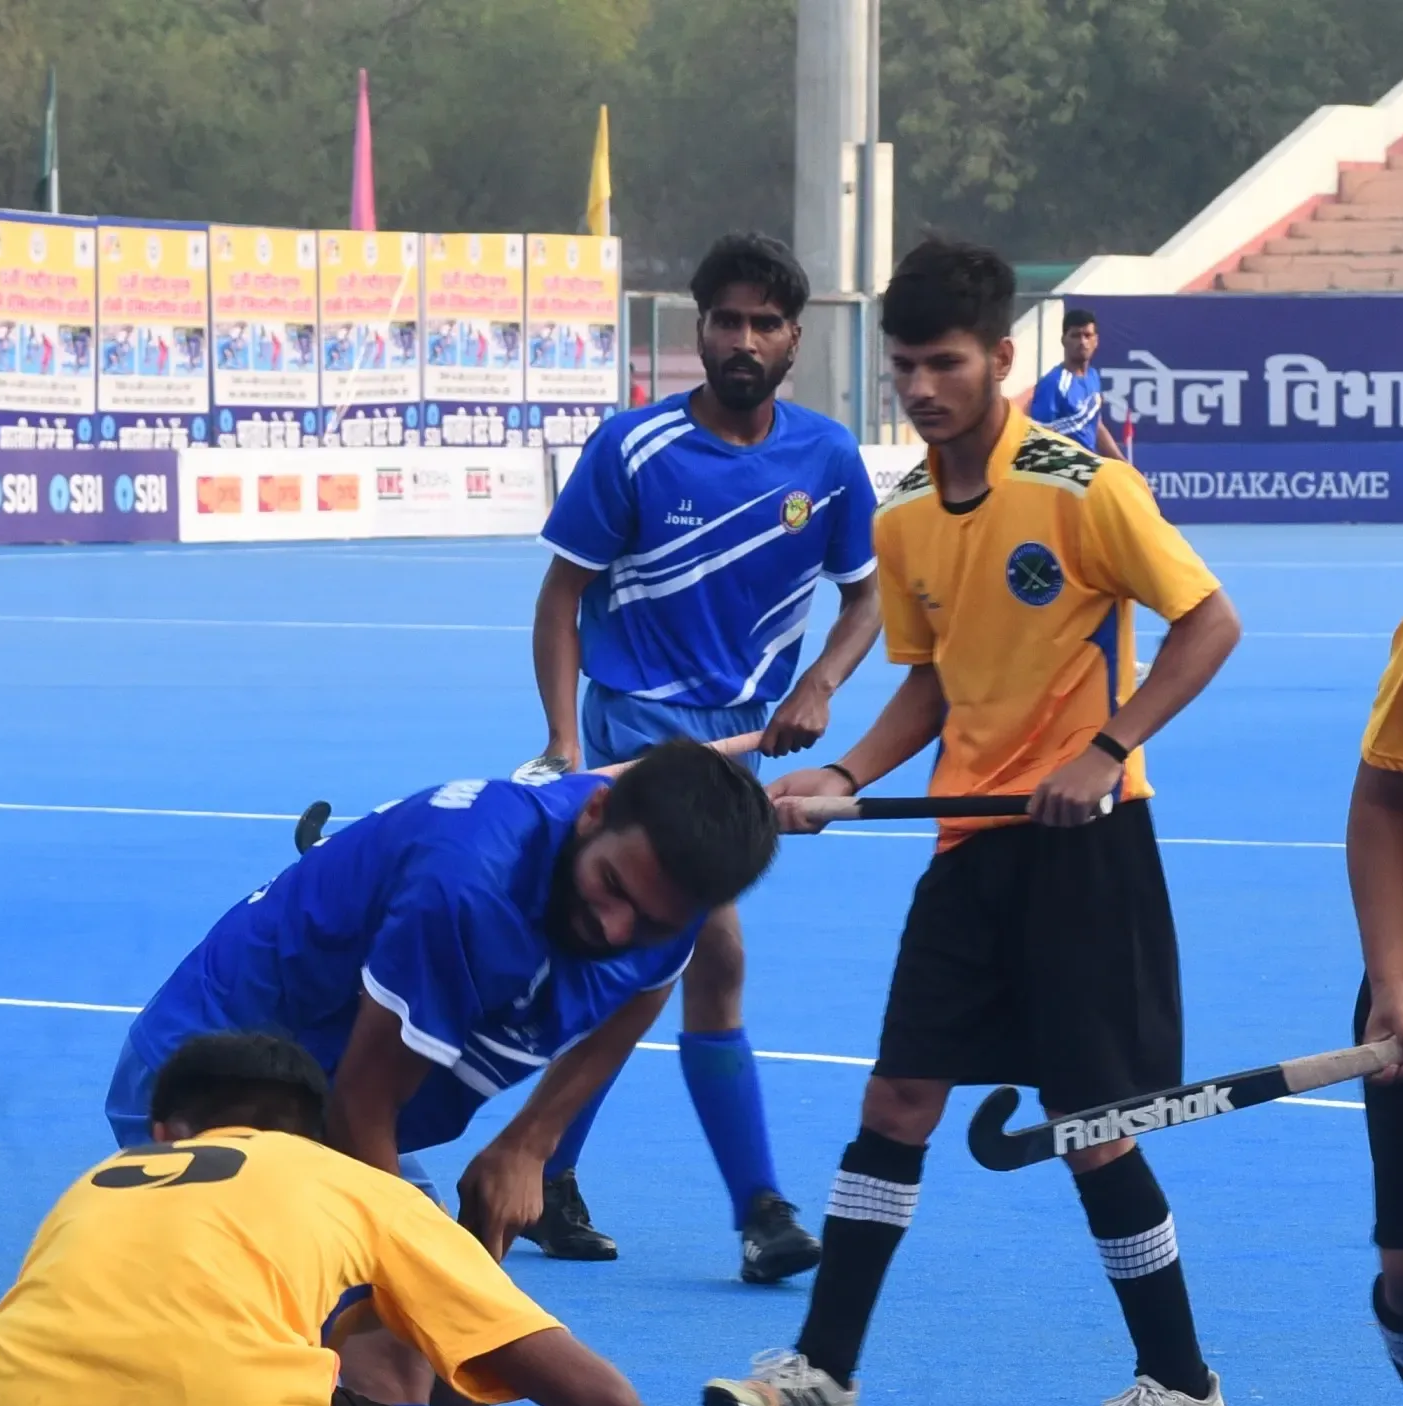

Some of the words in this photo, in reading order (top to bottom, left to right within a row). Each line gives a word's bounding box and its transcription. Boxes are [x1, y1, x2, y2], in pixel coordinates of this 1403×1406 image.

[1100, 350, 1249, 425] खेल
[2, 473, 38, 514] SBI
[69, 473, 104, 514] SBI
[134, 473, 168, 514] SBI
[1147, 471, 1390, 499] #INDIAKAGAME
[1052, 1083, 1235, 1156] Rakshak
